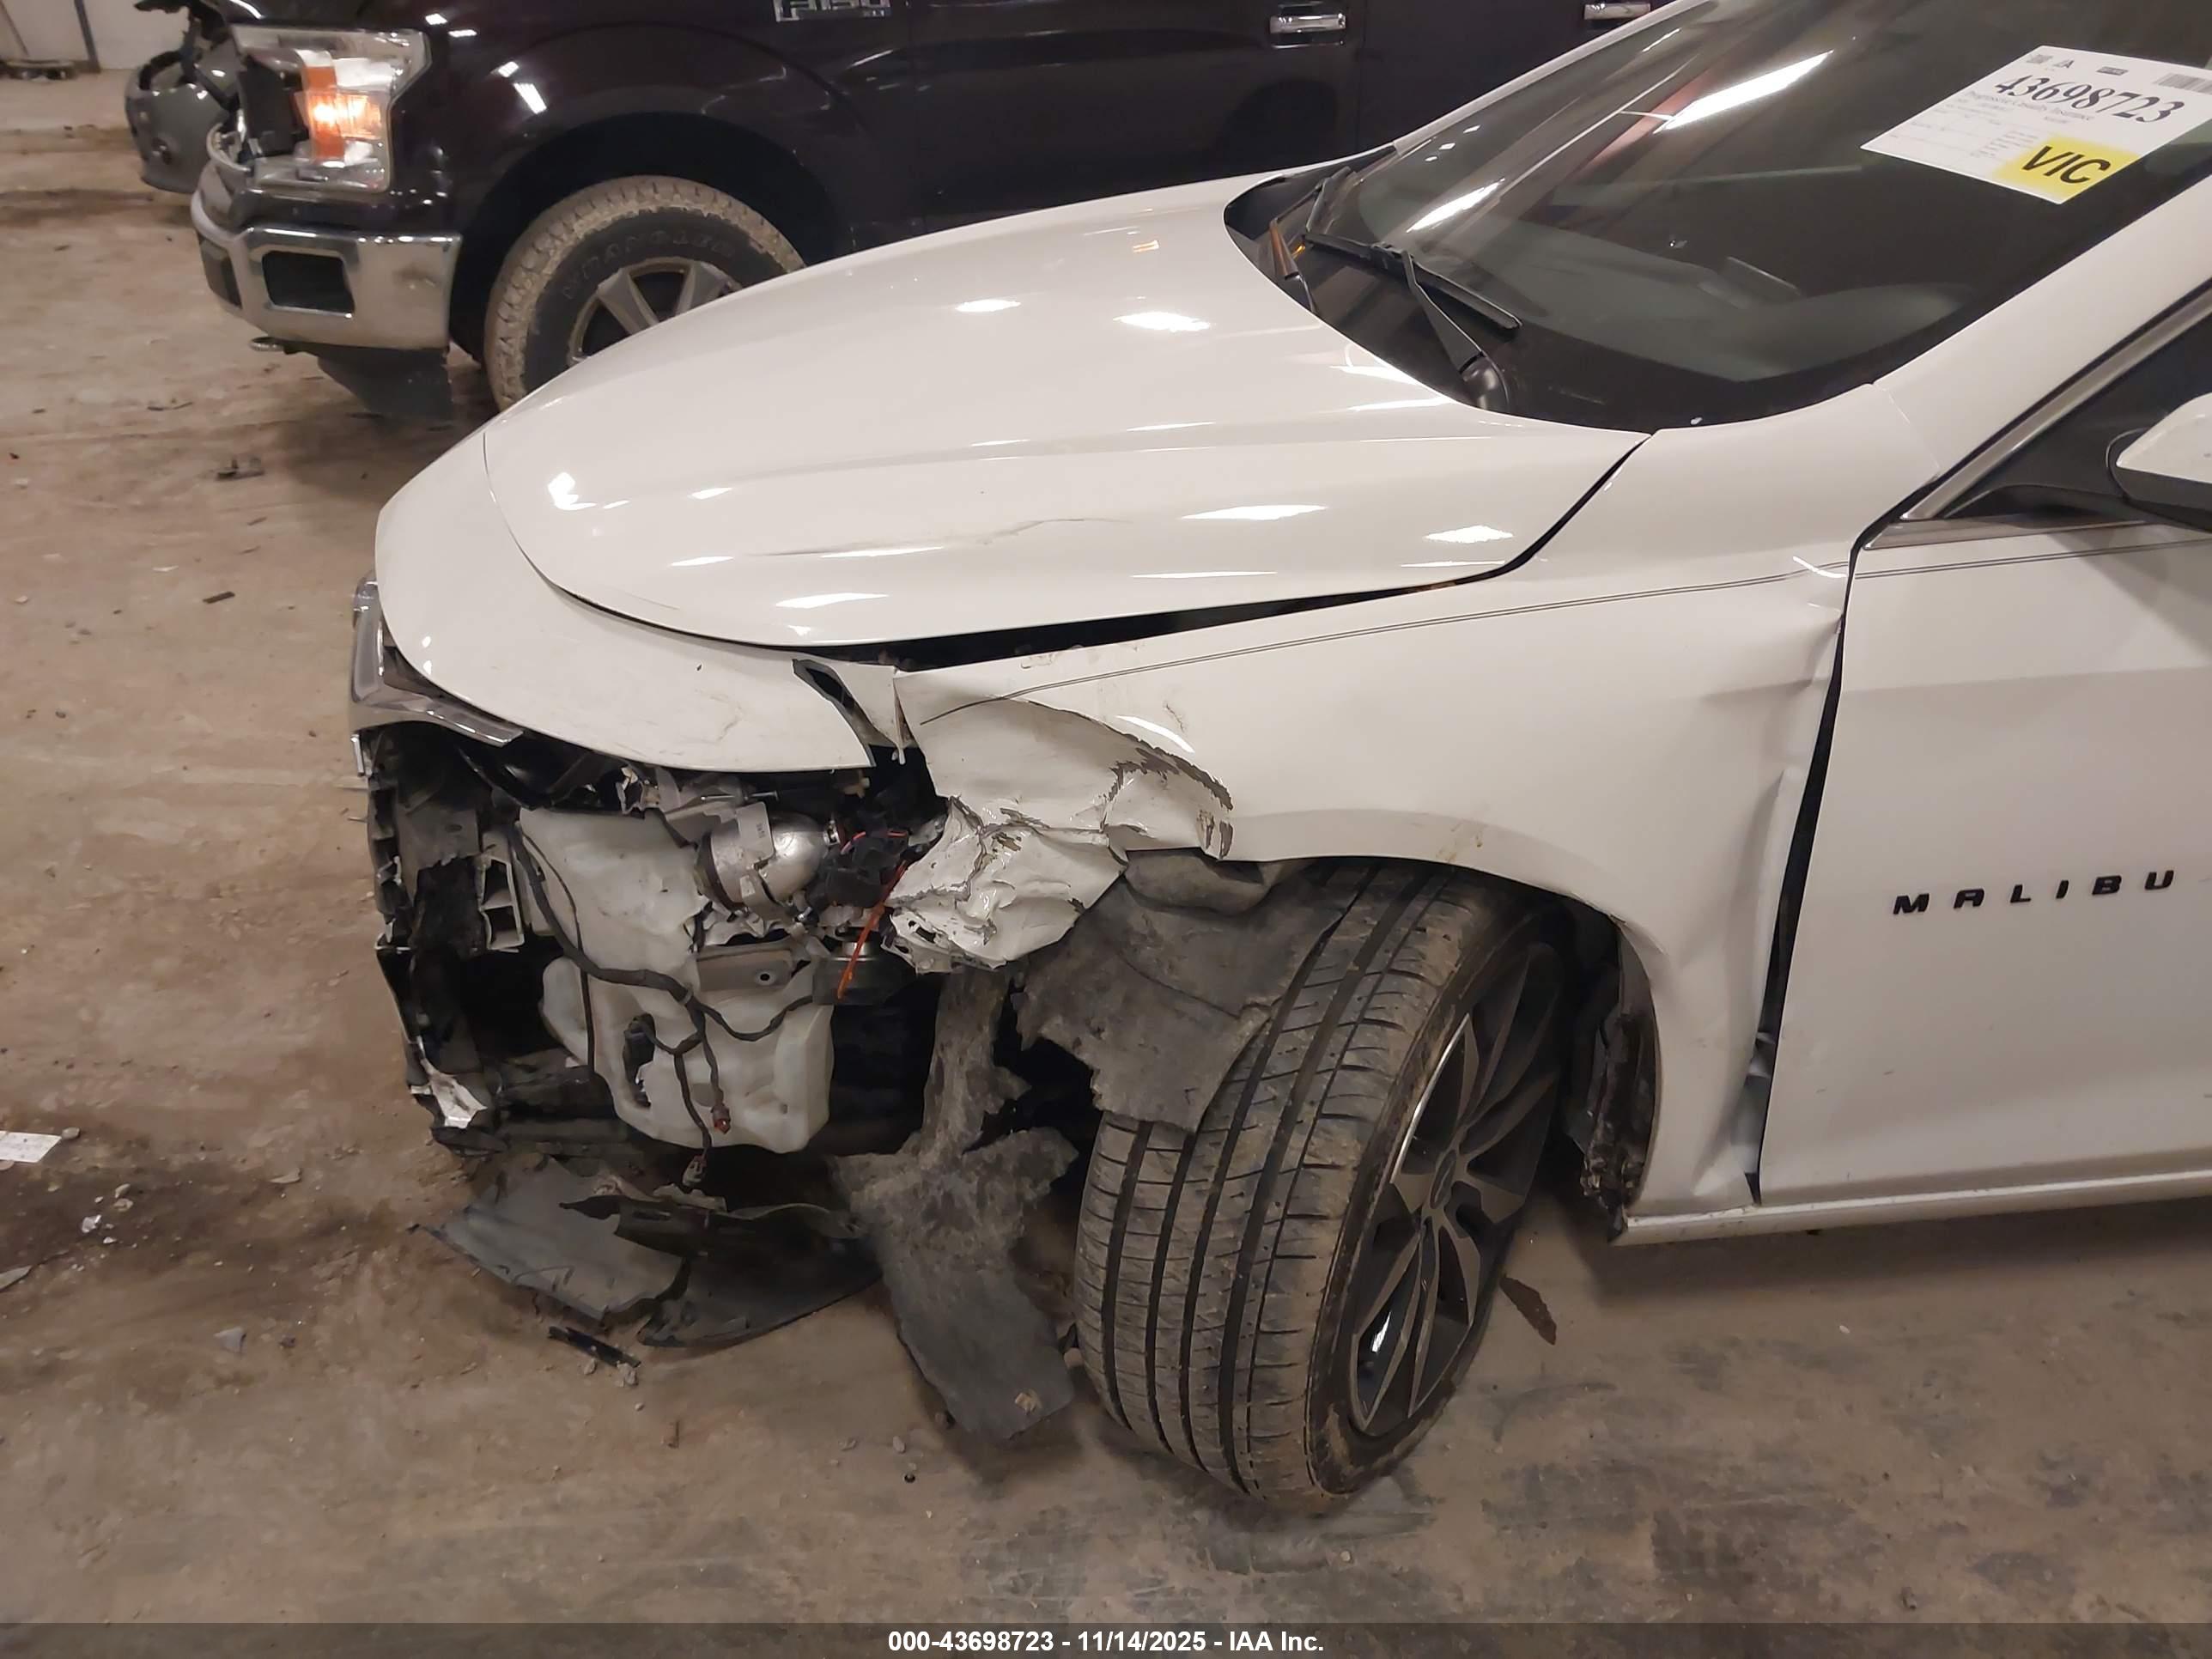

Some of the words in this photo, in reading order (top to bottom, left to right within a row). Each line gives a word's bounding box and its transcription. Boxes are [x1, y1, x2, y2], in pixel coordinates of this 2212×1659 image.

[1994, 75, 2185, 123] 43698723
[2021, 145, 2112, 185] VIC
[1893, 869, 2175, 915] MALIBU
